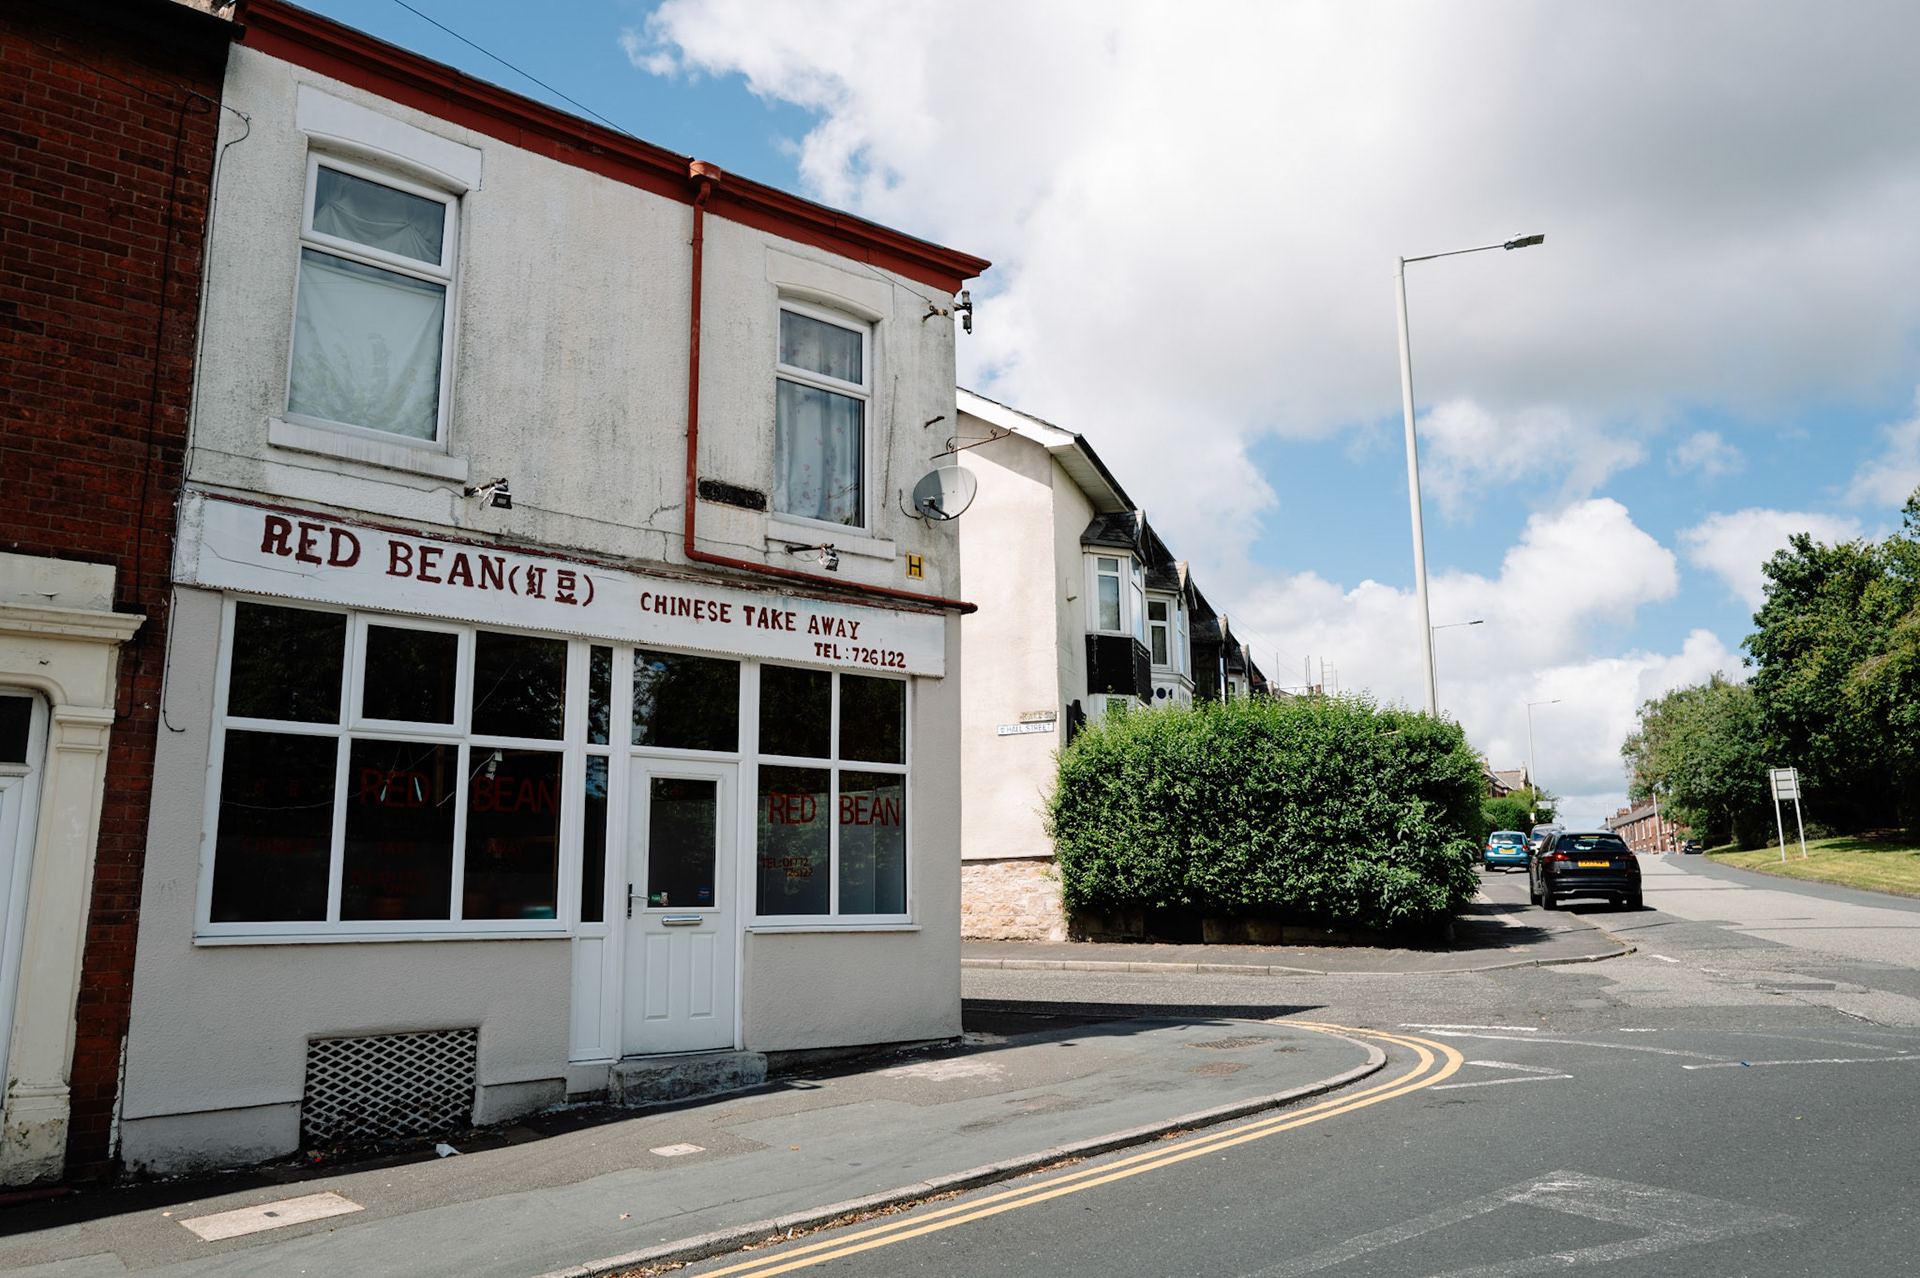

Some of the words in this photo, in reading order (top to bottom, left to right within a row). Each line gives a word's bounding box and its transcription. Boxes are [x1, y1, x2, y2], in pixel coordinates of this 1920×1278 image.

[260, 514, 362, 568] RED
[909, 555, 922, 577] H
[640, 592, 732, 624] CHINESE
[743, 606, 797, 632] TAKE
[807, 614, 861, 641] AWAY
[814, 642, 907, 669] TEL:726122
[1007, 724, 1023, 733] HALL
[1025, 723, 1051, 732] STREET
[360, 768, 430, 808] RED
[473, 775, 560, 814] BEAN
[769, 793, 817, 825] RED
[839, 794, 901, 827] BEAN
